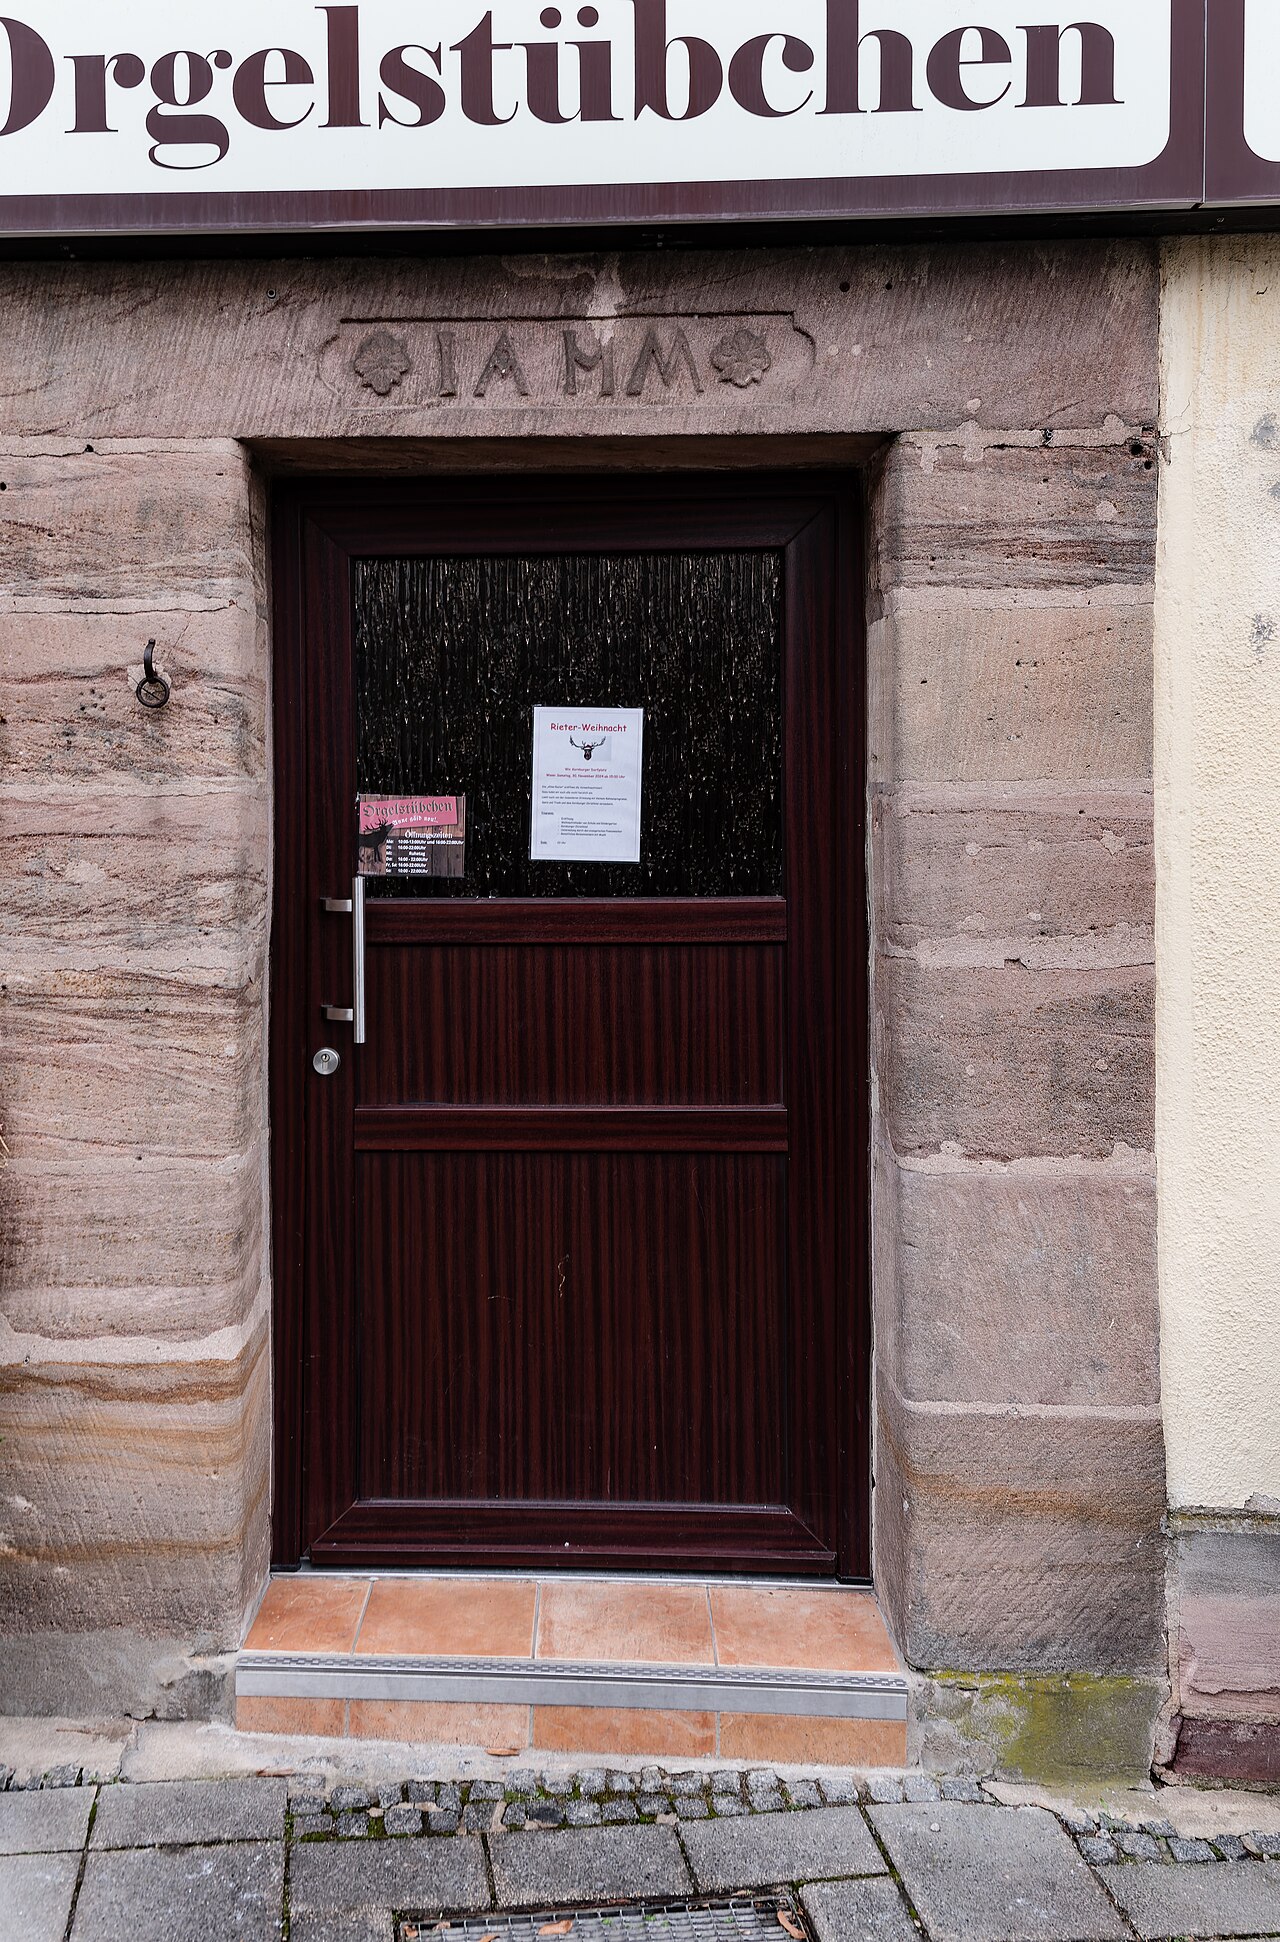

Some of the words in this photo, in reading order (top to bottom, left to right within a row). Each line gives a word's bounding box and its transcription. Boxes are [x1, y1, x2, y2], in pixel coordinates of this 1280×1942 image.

[550, 722, 627, 732] Rieter-Weihnacht
[363, 800, 453, 817] Orgelstübchen
[405, 829, 453, 840] Öffnungszeiten
